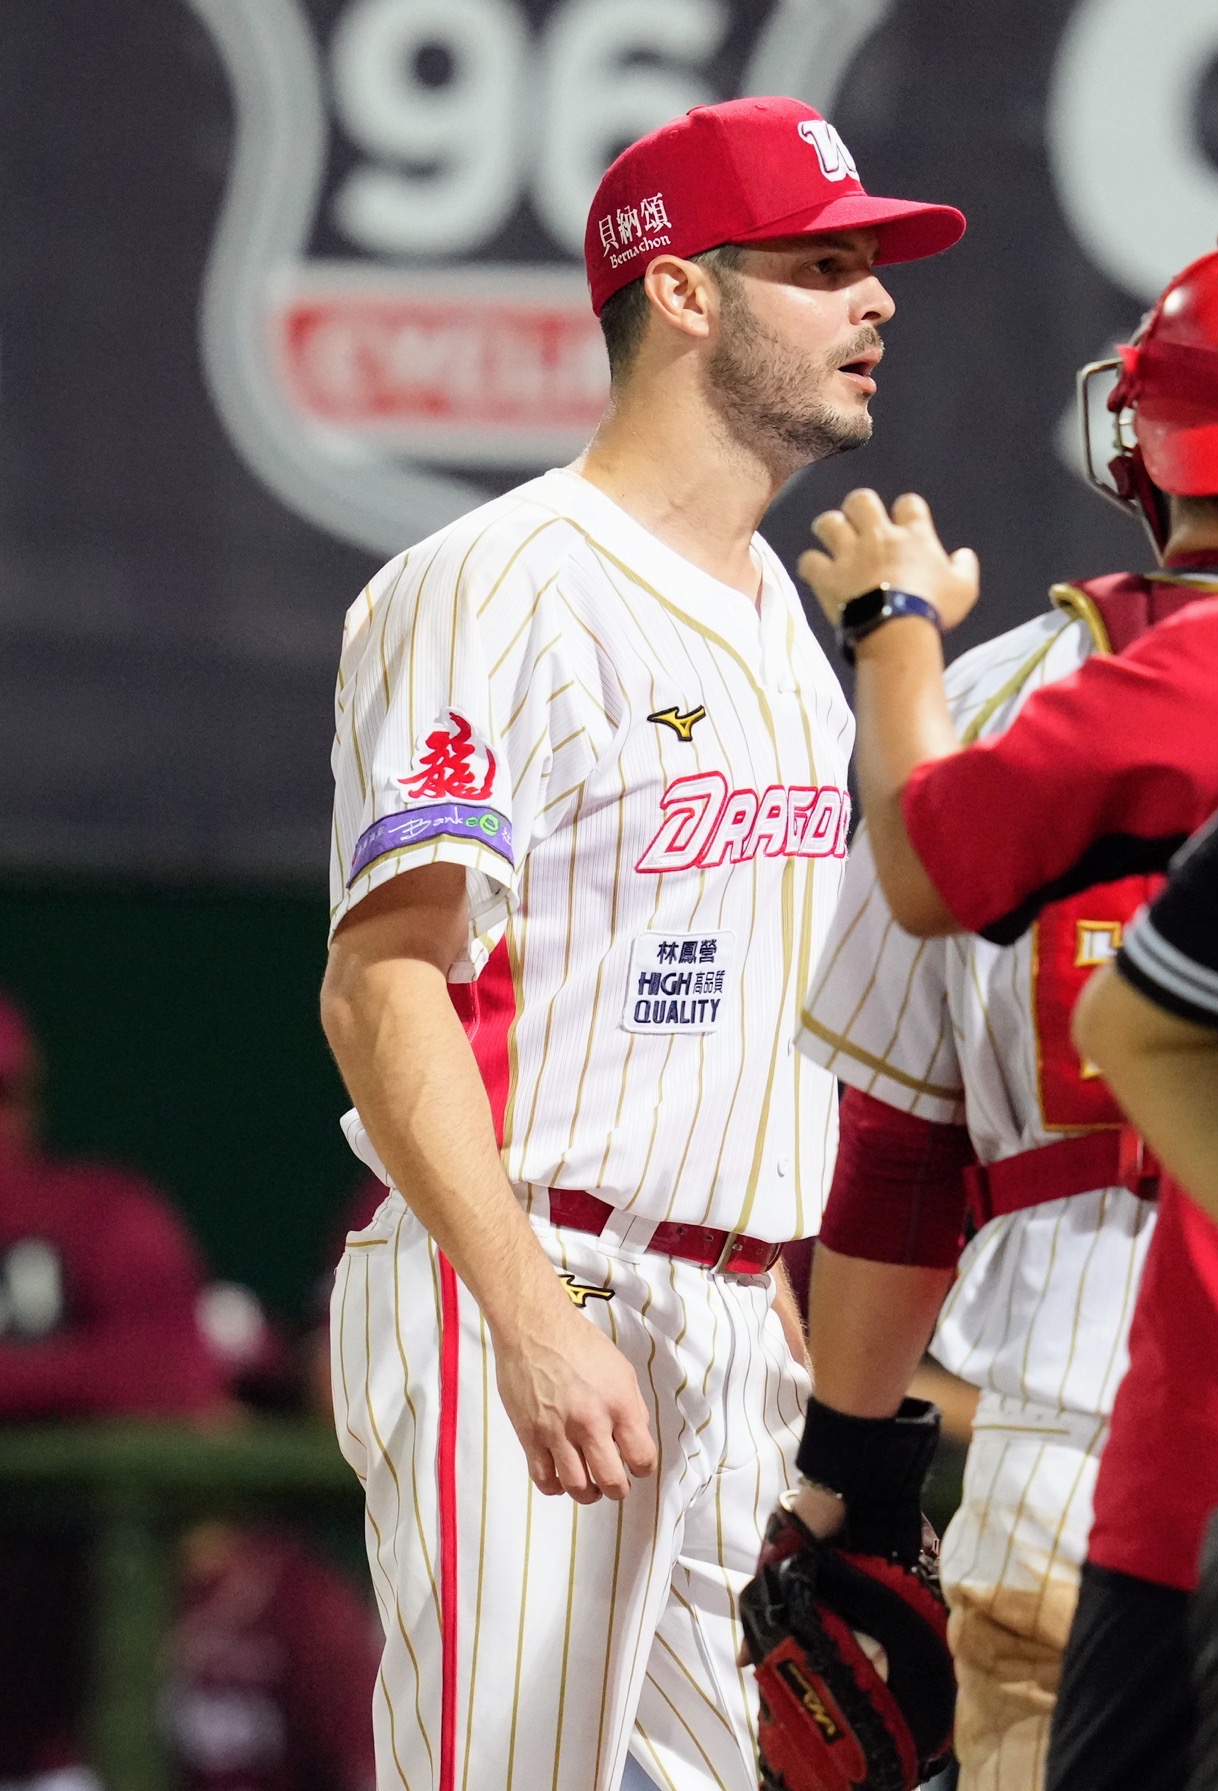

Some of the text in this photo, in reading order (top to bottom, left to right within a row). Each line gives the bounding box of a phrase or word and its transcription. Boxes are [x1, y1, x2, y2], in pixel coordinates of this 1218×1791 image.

[599, 192, 672, 257] 貝納頌
[609, 235, 671, 269] Bernachon
[635, 771, 852, 873] DRAGO
[656, 939, 718, 965] 林鳳營
[638, 970, 726, 996] HIGH 高品質
[633, 998, 721, 1024] QUALITY
